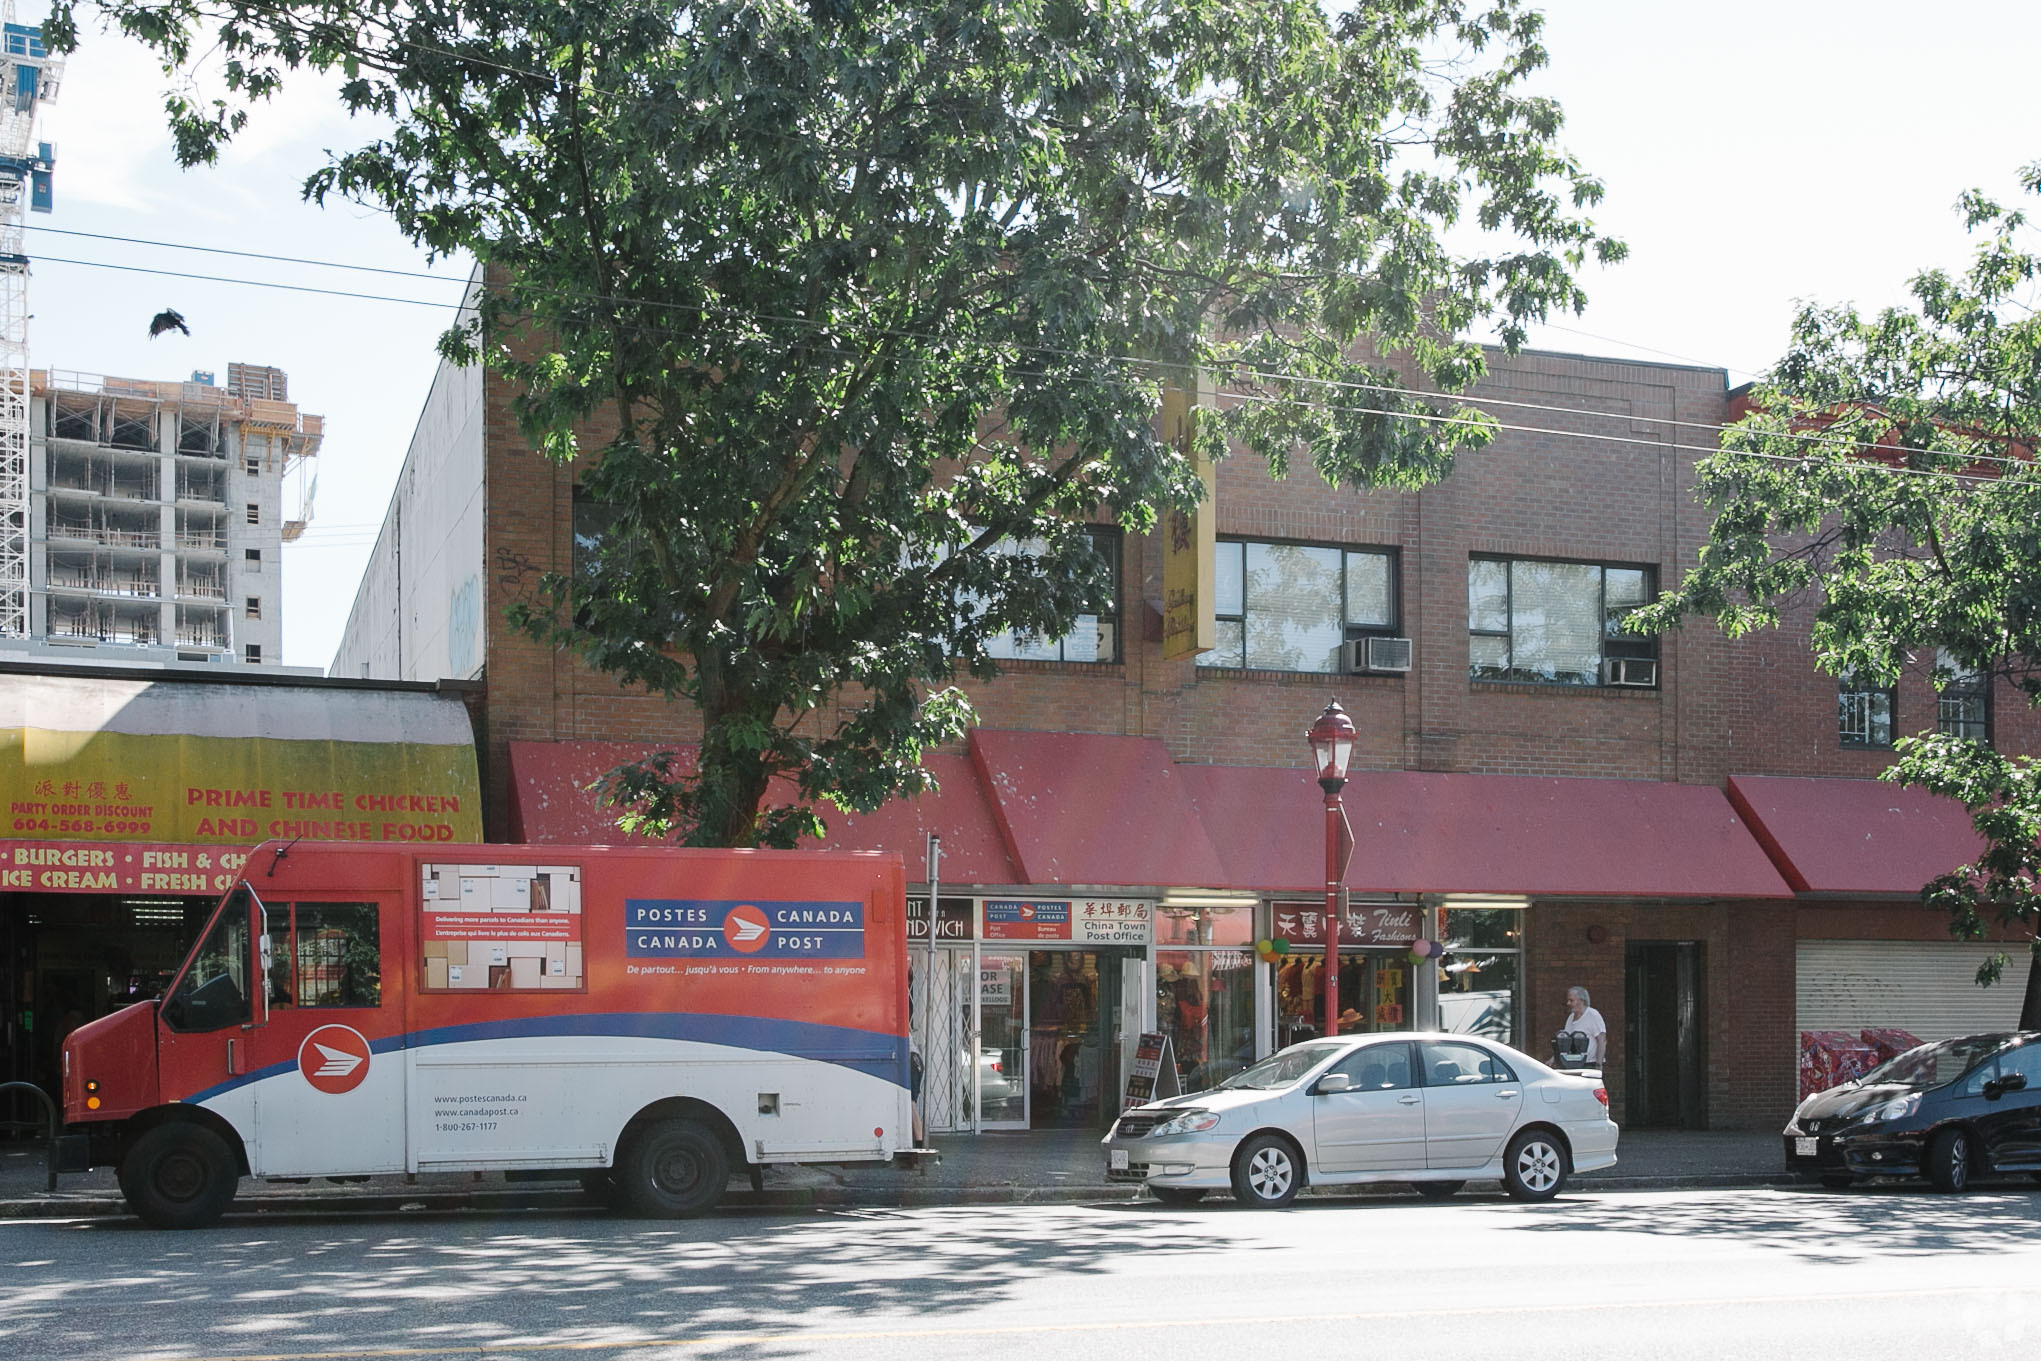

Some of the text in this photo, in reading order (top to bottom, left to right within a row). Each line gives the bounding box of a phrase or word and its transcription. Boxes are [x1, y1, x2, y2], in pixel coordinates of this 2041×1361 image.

[34, 780, 132, 801] 派對優惠
[187, 788, 459, 813] PRIME TIME CHICKEN
[10, 802, 153, 818] PARTY ORDER DISCOUNT
[13, 818, 151, 834] 604-568-6999
[196, 818, 454, 841] AND CHINESE FOOD
[14, 848, 115, 867] BURGERS
[143, 852, 188, 868] FISH
[196, 853, 211, 869] &
[2, 870, 32, 886] ICE
[40, 871, 118, 889] CREAM
[141, 873, 206, 890] FRESH
[637, 909, 708, 921] POSTES
[777, 910, 854, 923] CANADA
[1083, 901, 1148, 920] 華埠郵局
[1373, 909, 1413, 927] Tinli
[1084, 921, 1146, 930] China Town
[1086, 931, 1144, 940] Post Office
[1371, 929, 1416, 943] Fashions
[637, 936, 718, 949] CANADA
[778, 937, 824, 949] POST
[626, 965, 640, 974] De
[684, 965, 717, 976] jusqu'à
[747, 965, 770, 974] From
[834, 967, 867, 976] anyone
[434, 1094, 527, 1104] www.postescanada.ca
[434, 1108, 519, 1117] www.canadapost.ca
[436, 1122, 498, 1131] 1-800-267-1177
